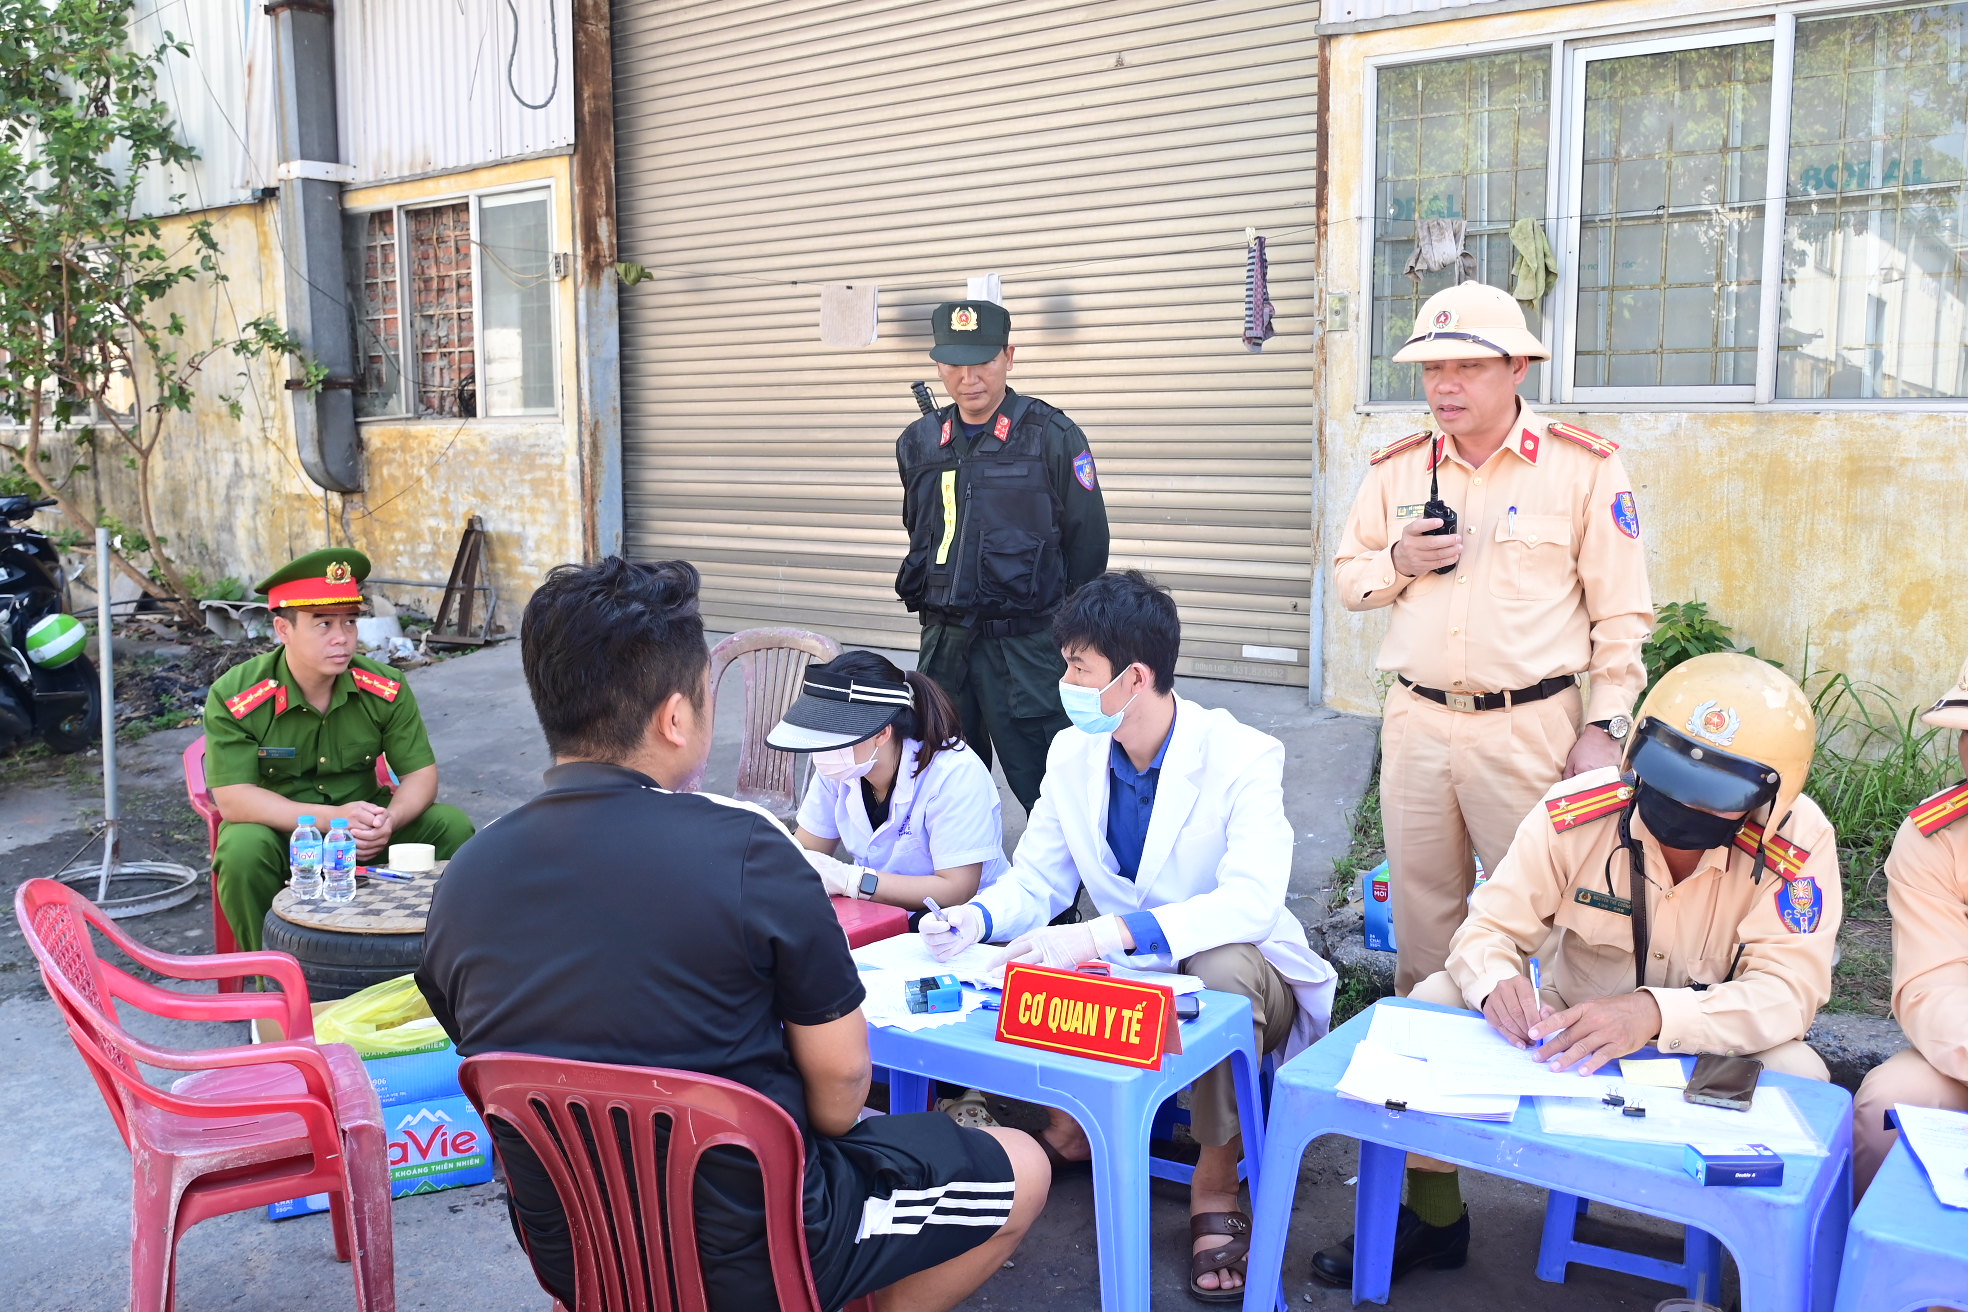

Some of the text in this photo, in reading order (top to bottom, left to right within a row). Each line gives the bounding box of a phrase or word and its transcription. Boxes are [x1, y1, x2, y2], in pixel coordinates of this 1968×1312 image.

[1391, 193, 1460, 219] ORAL
[942, 484, 953, 550] POLICE
[1018, 991, 1148, 1045] CƠ QUAN Y TẾ
[388, 1124, 479, 1167] aVie
[431, 1162, 454, 1172] THIÊN
[456, 1157, 480, 1168] NHIÊN
